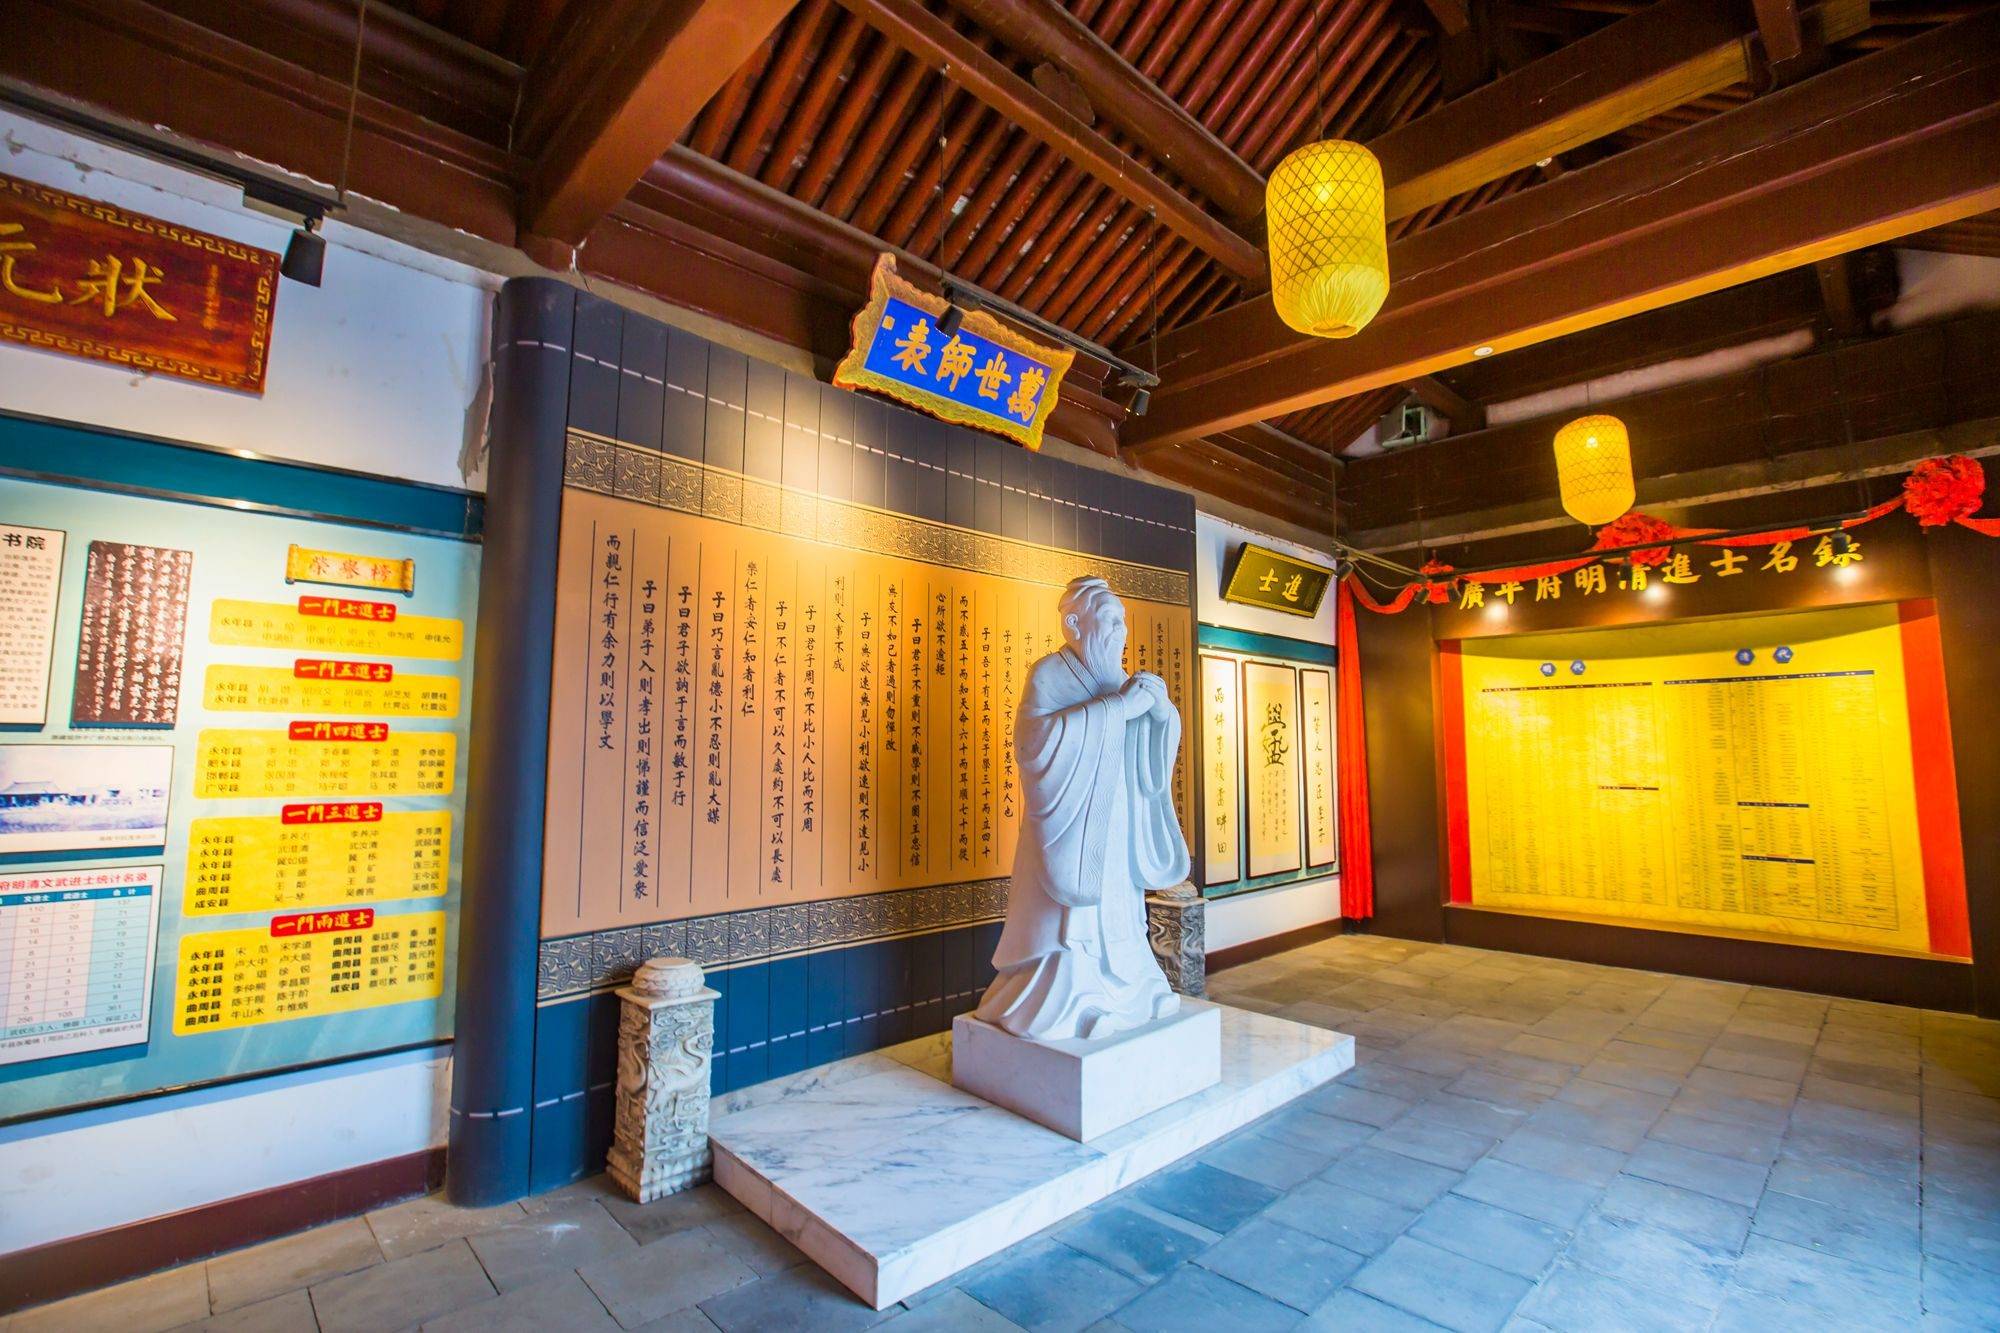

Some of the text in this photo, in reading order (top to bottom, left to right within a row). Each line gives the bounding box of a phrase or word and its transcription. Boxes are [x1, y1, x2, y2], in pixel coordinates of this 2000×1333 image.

[2, 532, 46, 550] 书院
[1259, 568, 1302, 602] 進士
[304, 599, 392, 619] 一門七進士
[300, 660, 389, 679] 一門五進士
[294, 722, 385, 739] 一門四進士
[287, 804, 379, 822] 一門三進士
